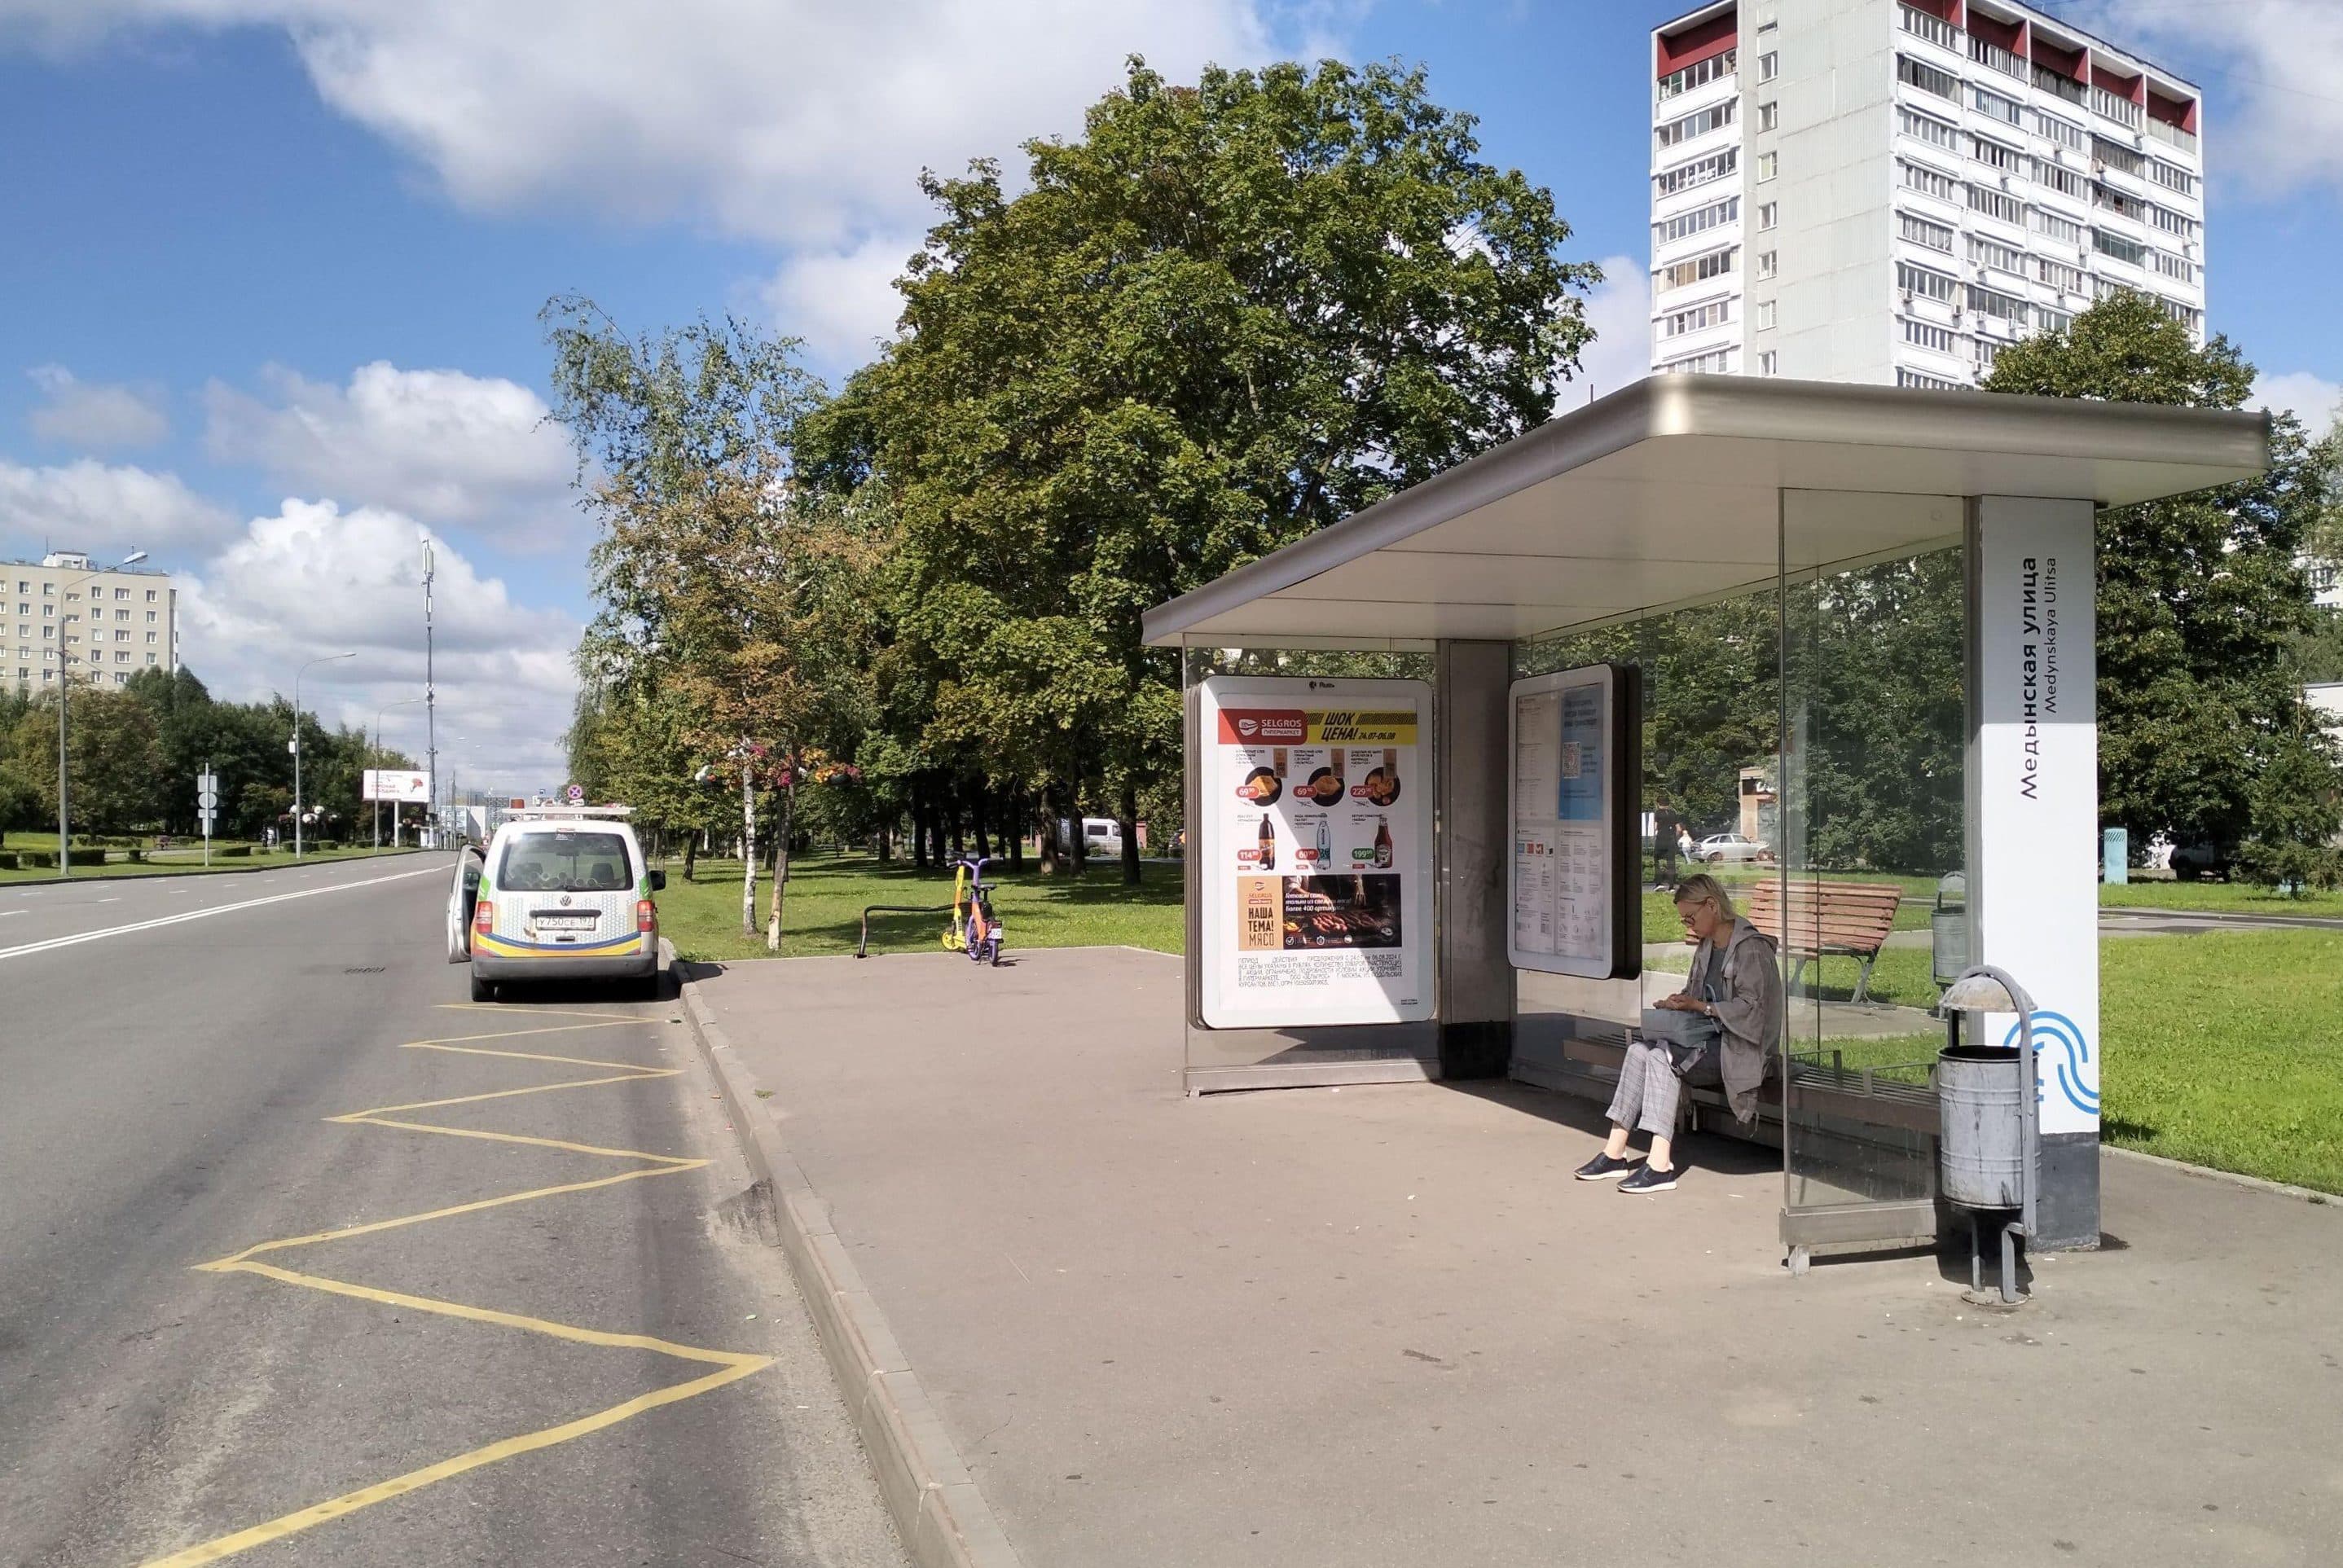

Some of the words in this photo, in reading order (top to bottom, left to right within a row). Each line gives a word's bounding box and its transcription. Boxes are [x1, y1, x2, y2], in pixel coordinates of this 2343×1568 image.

[2044, 557, 2056, 603] Ulitsa
[2023, 557, 2041, 635] улица
[2044, 609, 2059, 713] Medynskaya
[1261, 718, 1302, 728] SELGROS
[1325, 712, 1356, 726] ШОК
[2020, 643, 2040, 799] Медынская
[1321, 727, 1359, 741] ЦЕНА!
[1248, 907, 1273, 919] НАША
[1247, 920, 1274, 932] ТЕМА!
[1249, 933, 1274, 946] МЯСО
